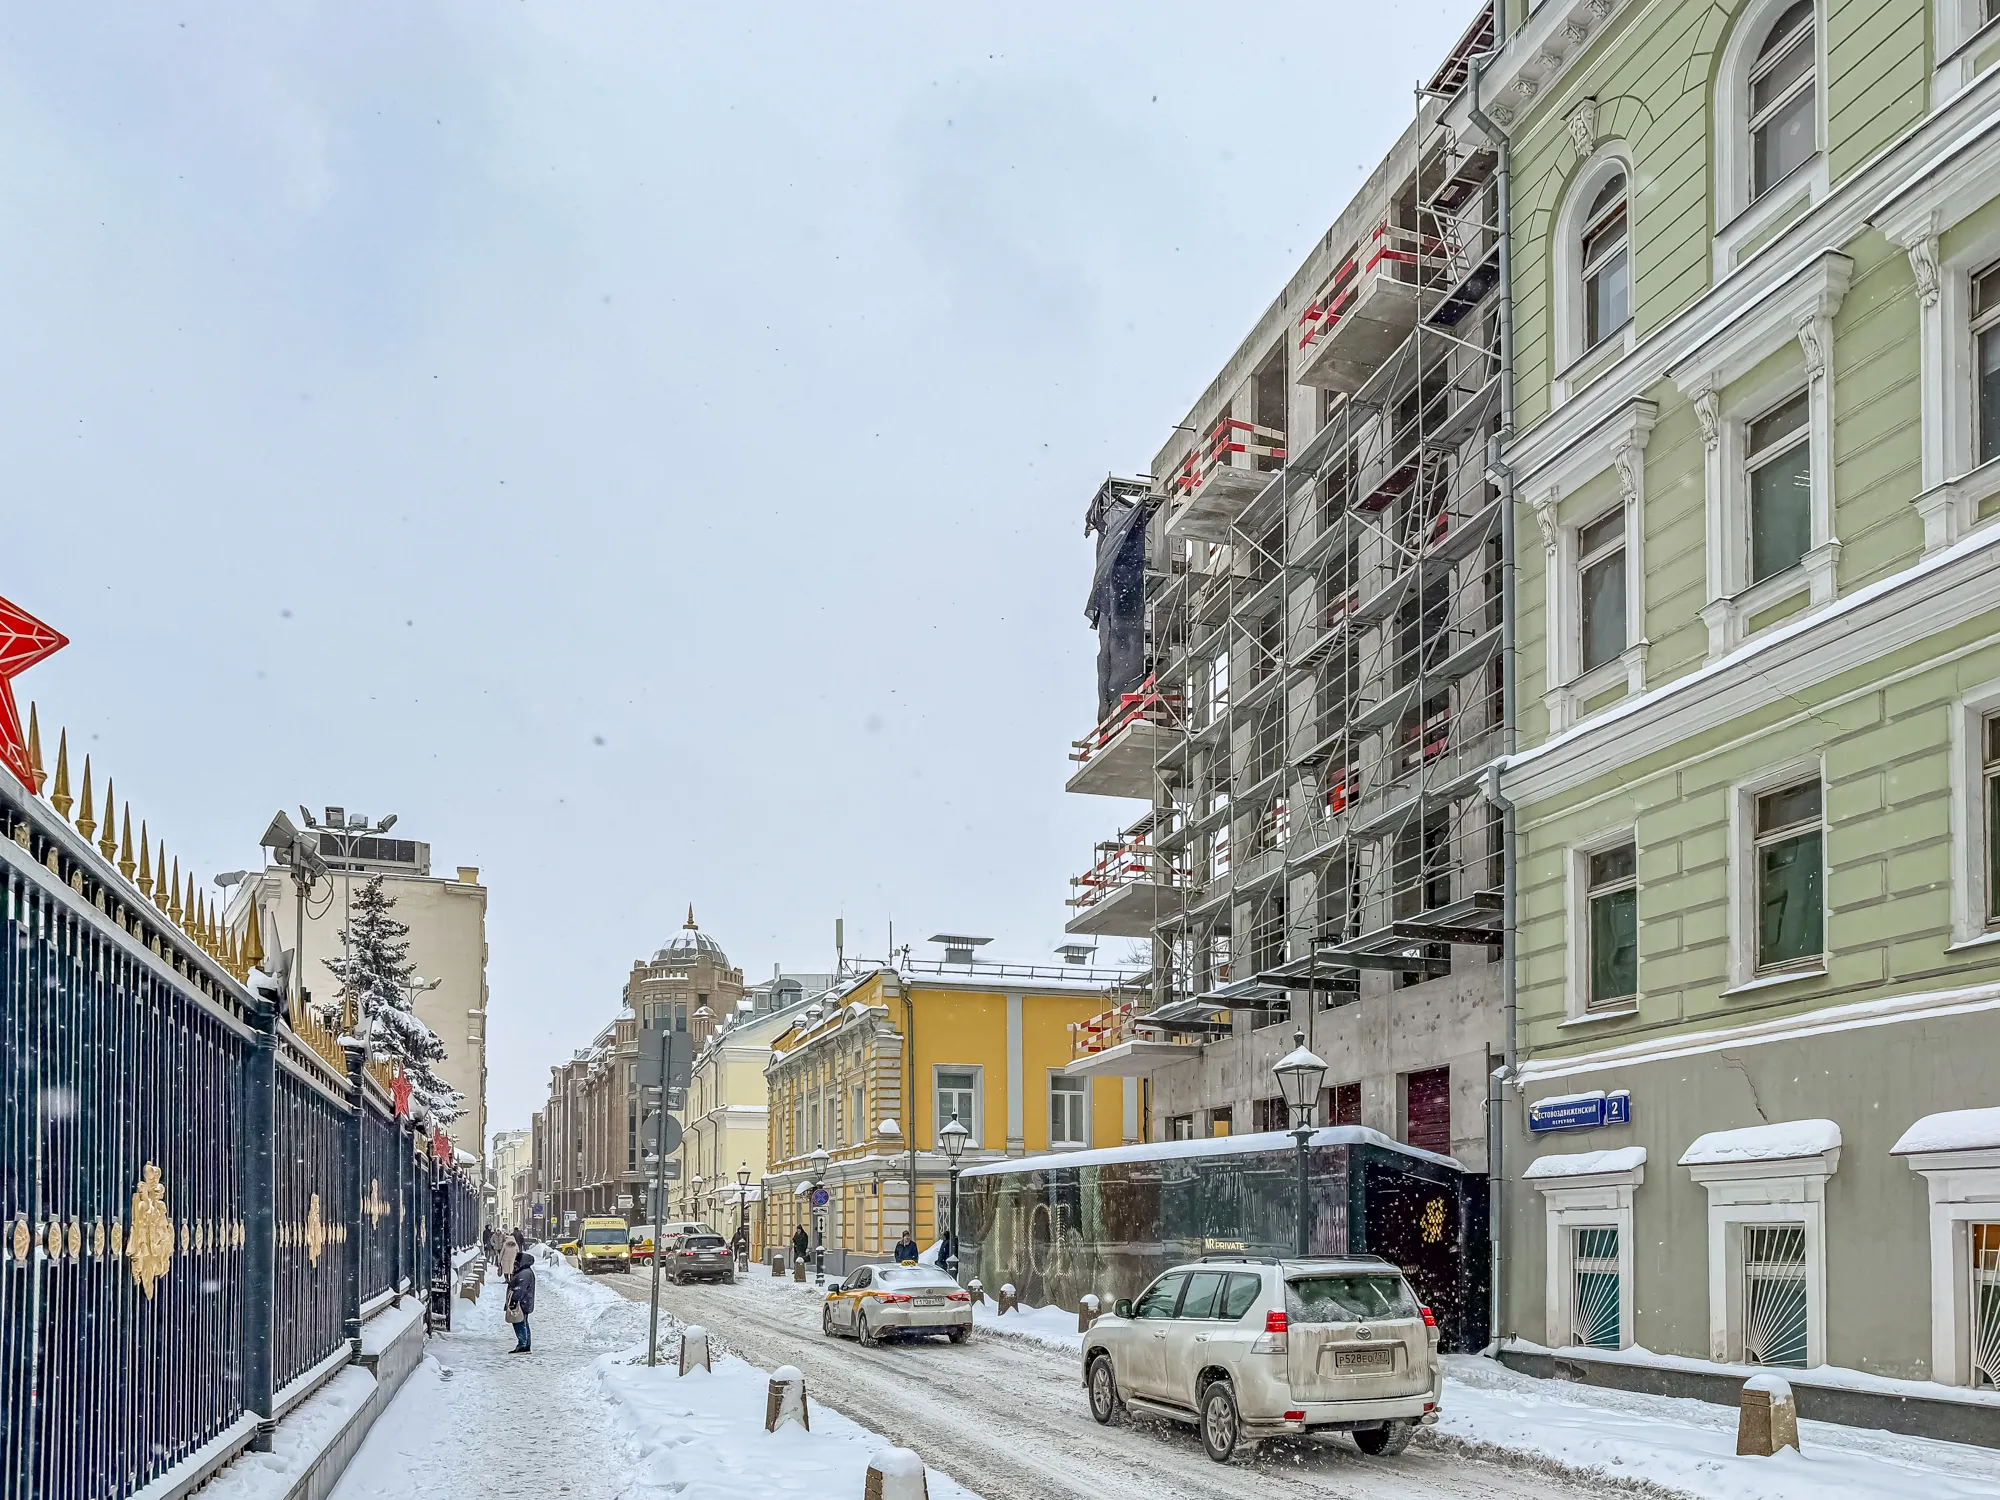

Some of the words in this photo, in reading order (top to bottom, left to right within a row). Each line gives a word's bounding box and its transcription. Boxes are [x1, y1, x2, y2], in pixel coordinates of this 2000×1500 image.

[1532, 1104, 1596, 1120] ЕСТОВОЗДВИЖЕНСКИЙ
[1611, 1101, 1618, 1114] 2
[1552, 1117, 1576, 1125] ПЕРЕУЛОК
[1215, 1241, 1245, 1250] PRIVATE
